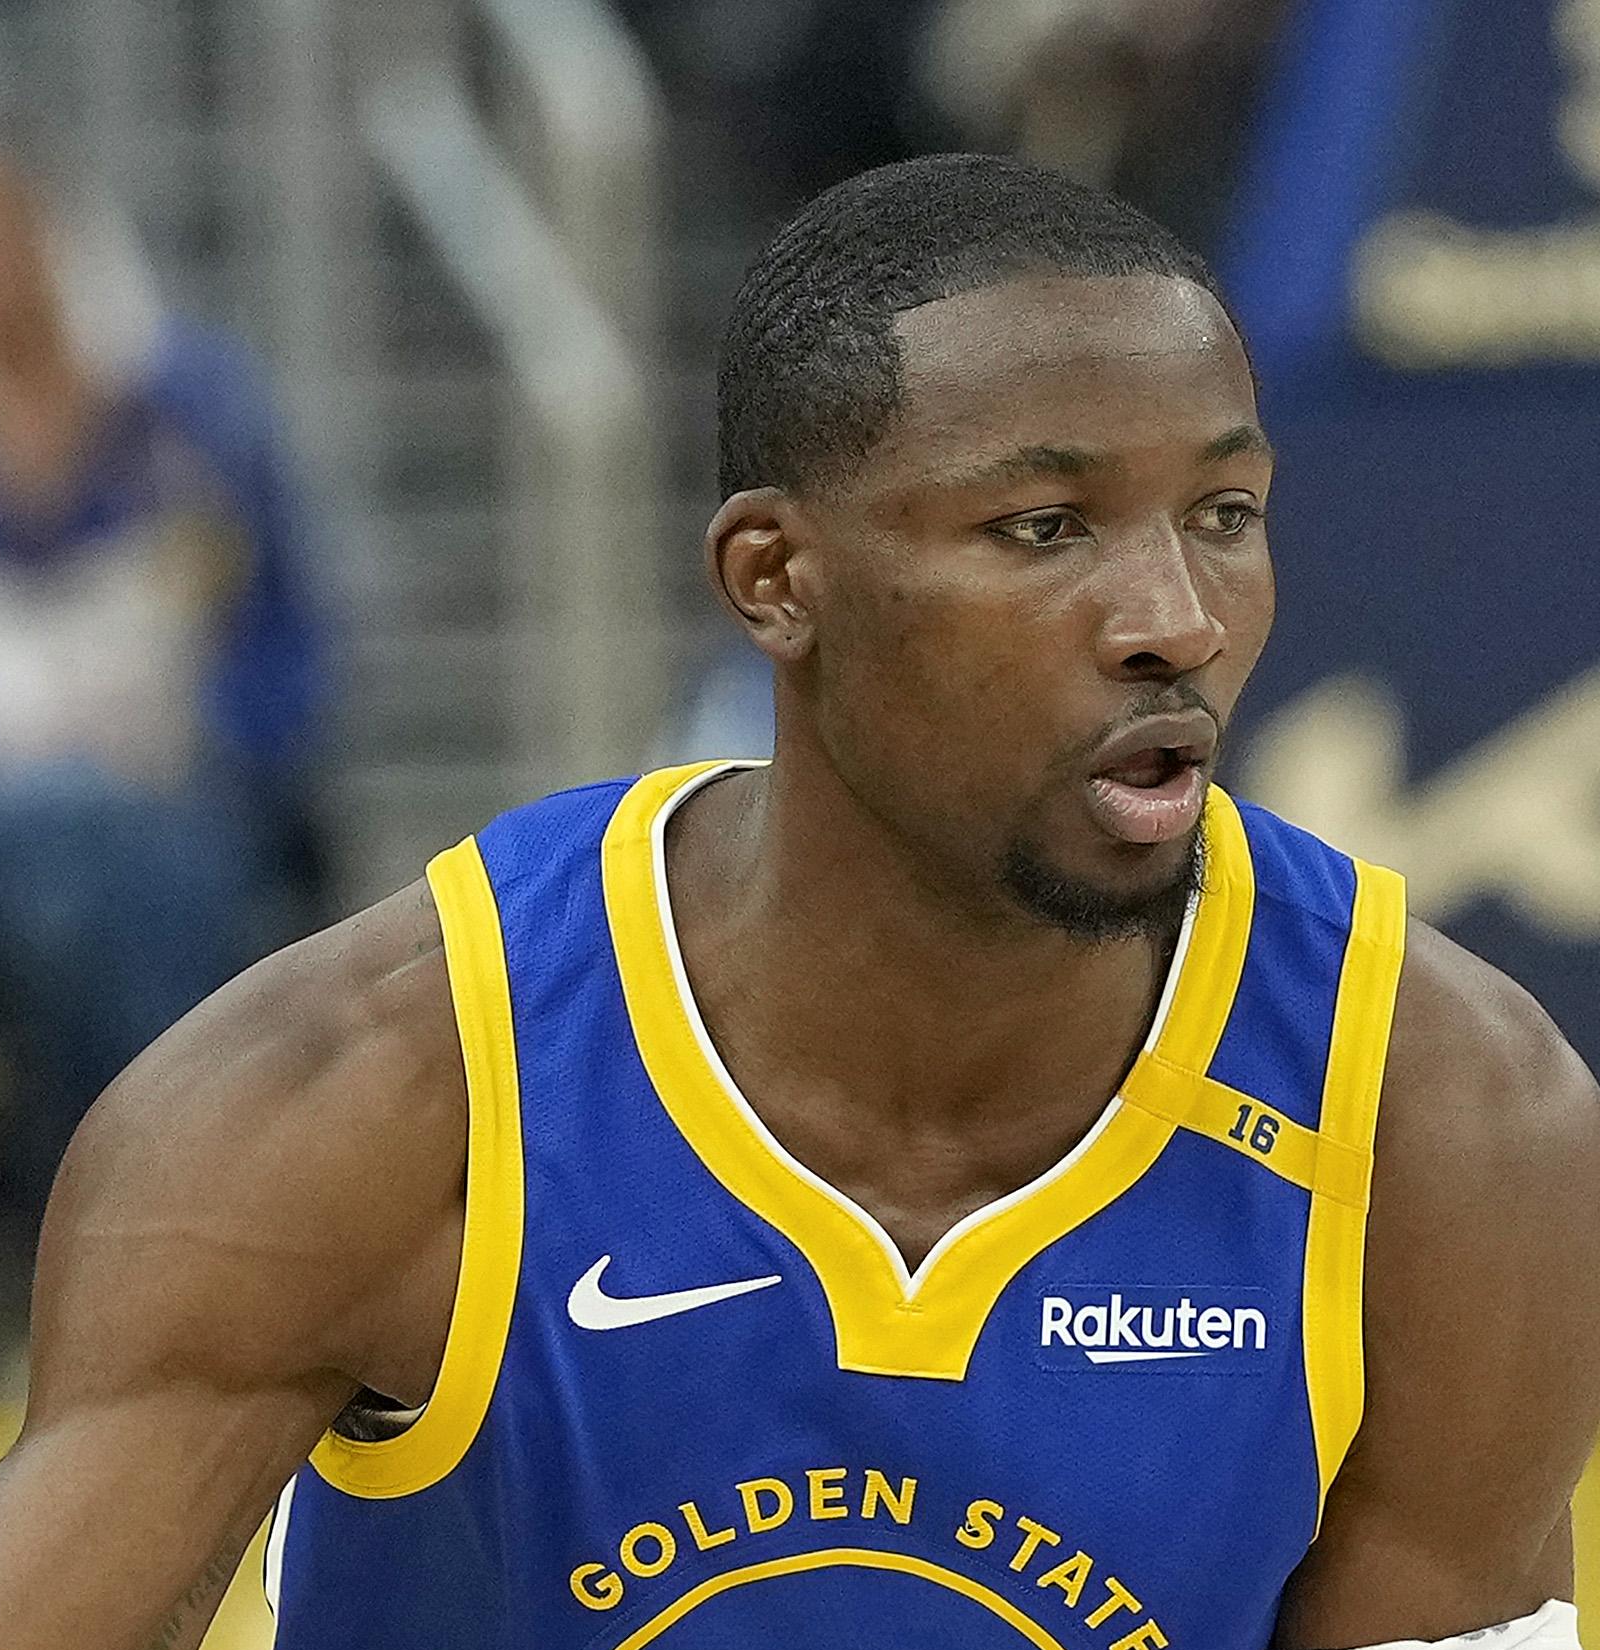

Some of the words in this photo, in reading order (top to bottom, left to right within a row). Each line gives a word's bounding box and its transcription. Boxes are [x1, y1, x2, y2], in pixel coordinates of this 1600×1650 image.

[1228, 1103, 1281, 1156] 16
[1040, 1293, 1266, 1350] Rakuten
[569, 1467, 918, 1611] GOLDEN
